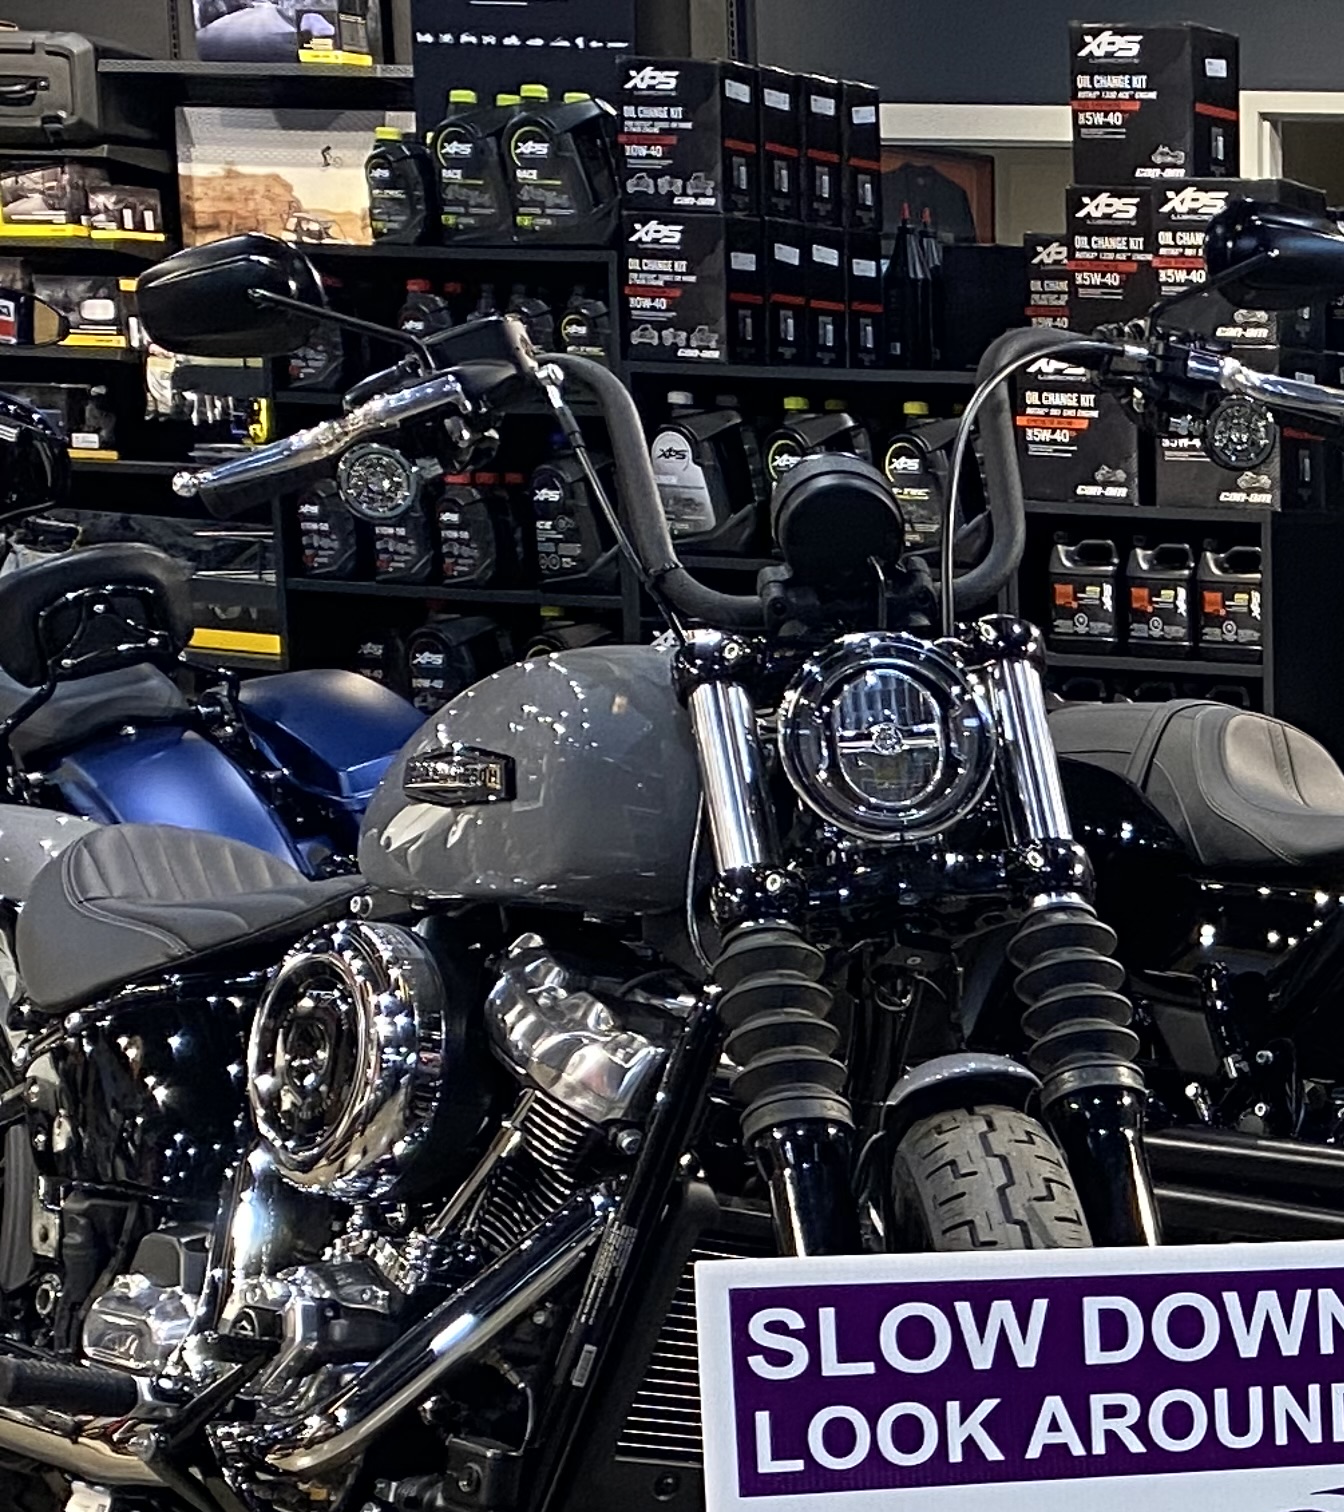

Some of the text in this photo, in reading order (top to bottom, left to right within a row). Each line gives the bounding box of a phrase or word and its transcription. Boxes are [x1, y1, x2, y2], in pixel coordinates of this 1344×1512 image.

[1077, 31, 1143, 56] XPS
[623, 66, 680, 90] XPS
[1077, 75, 1147, 88] OIL CHANGE KIT
[1075, 192, 1140, 218] XPS
[1159, 187, 1229, 216] XPS
[628, 220, 684, 243] XPS
[1158, 231, 1205, 246] OIL CHAN
[1031, 242, 1069, 264] XP
[1074, 236, 1145, 251] OIL CHANGE KIT
[1026, 392, 1096, 407] OIL CHANGE KIT
[657, 447, 688, 460] XPS
[889, 456, 920, 470] XPS
[746, 1298, 1049, 1381] SLOW
[754, 1398, 1004, 1475] LOOK
